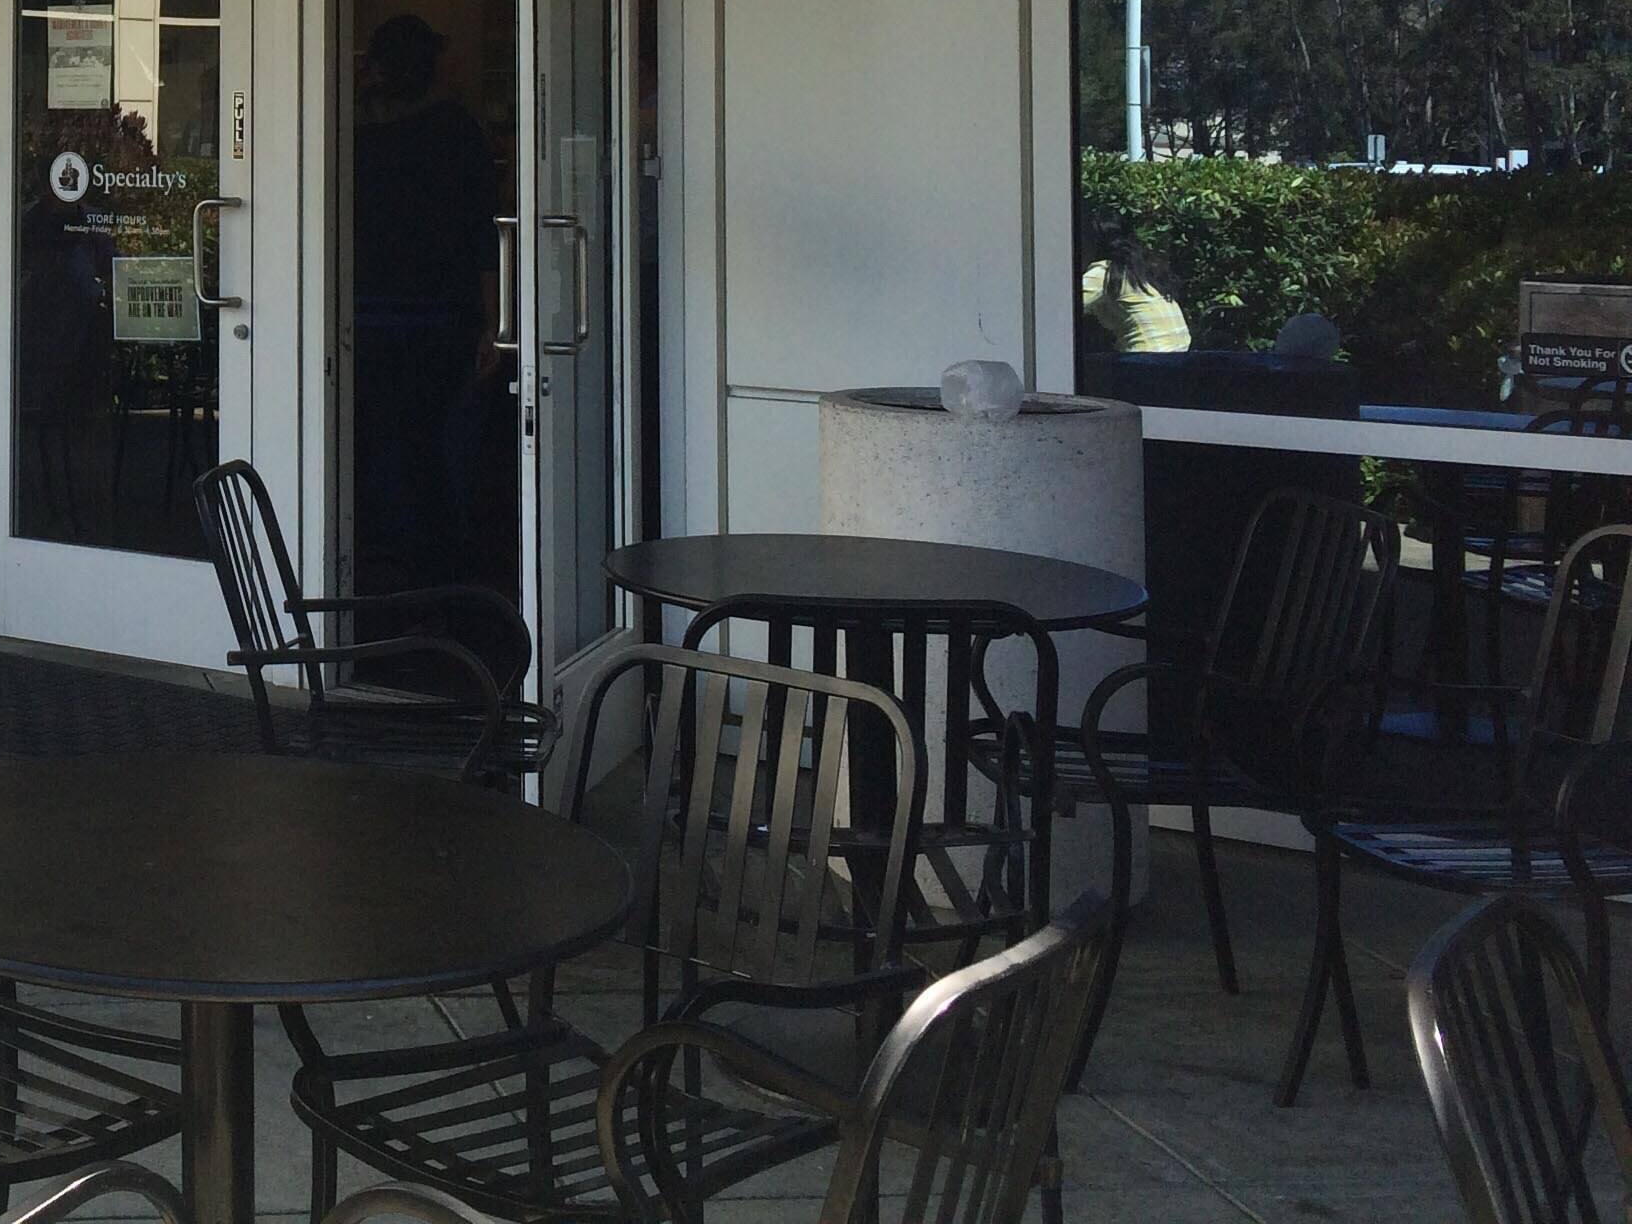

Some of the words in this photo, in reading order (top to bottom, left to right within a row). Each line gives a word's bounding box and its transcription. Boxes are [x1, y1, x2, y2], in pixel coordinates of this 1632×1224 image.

[234, 97, 244, 143] PULL
[92, 163, 188, 196] Specialty's
[86, 213, 114, 225] STORE
[115, 215, 147, 226] HOURS
[1528, 344, 1567, 357] Thank
[1569, 346, 1592, 358] You
[1594, 348, 1616, 359] For
[1528, 355, 1551, 367] Not
[1553, 357, 1607, 372] Smoking
